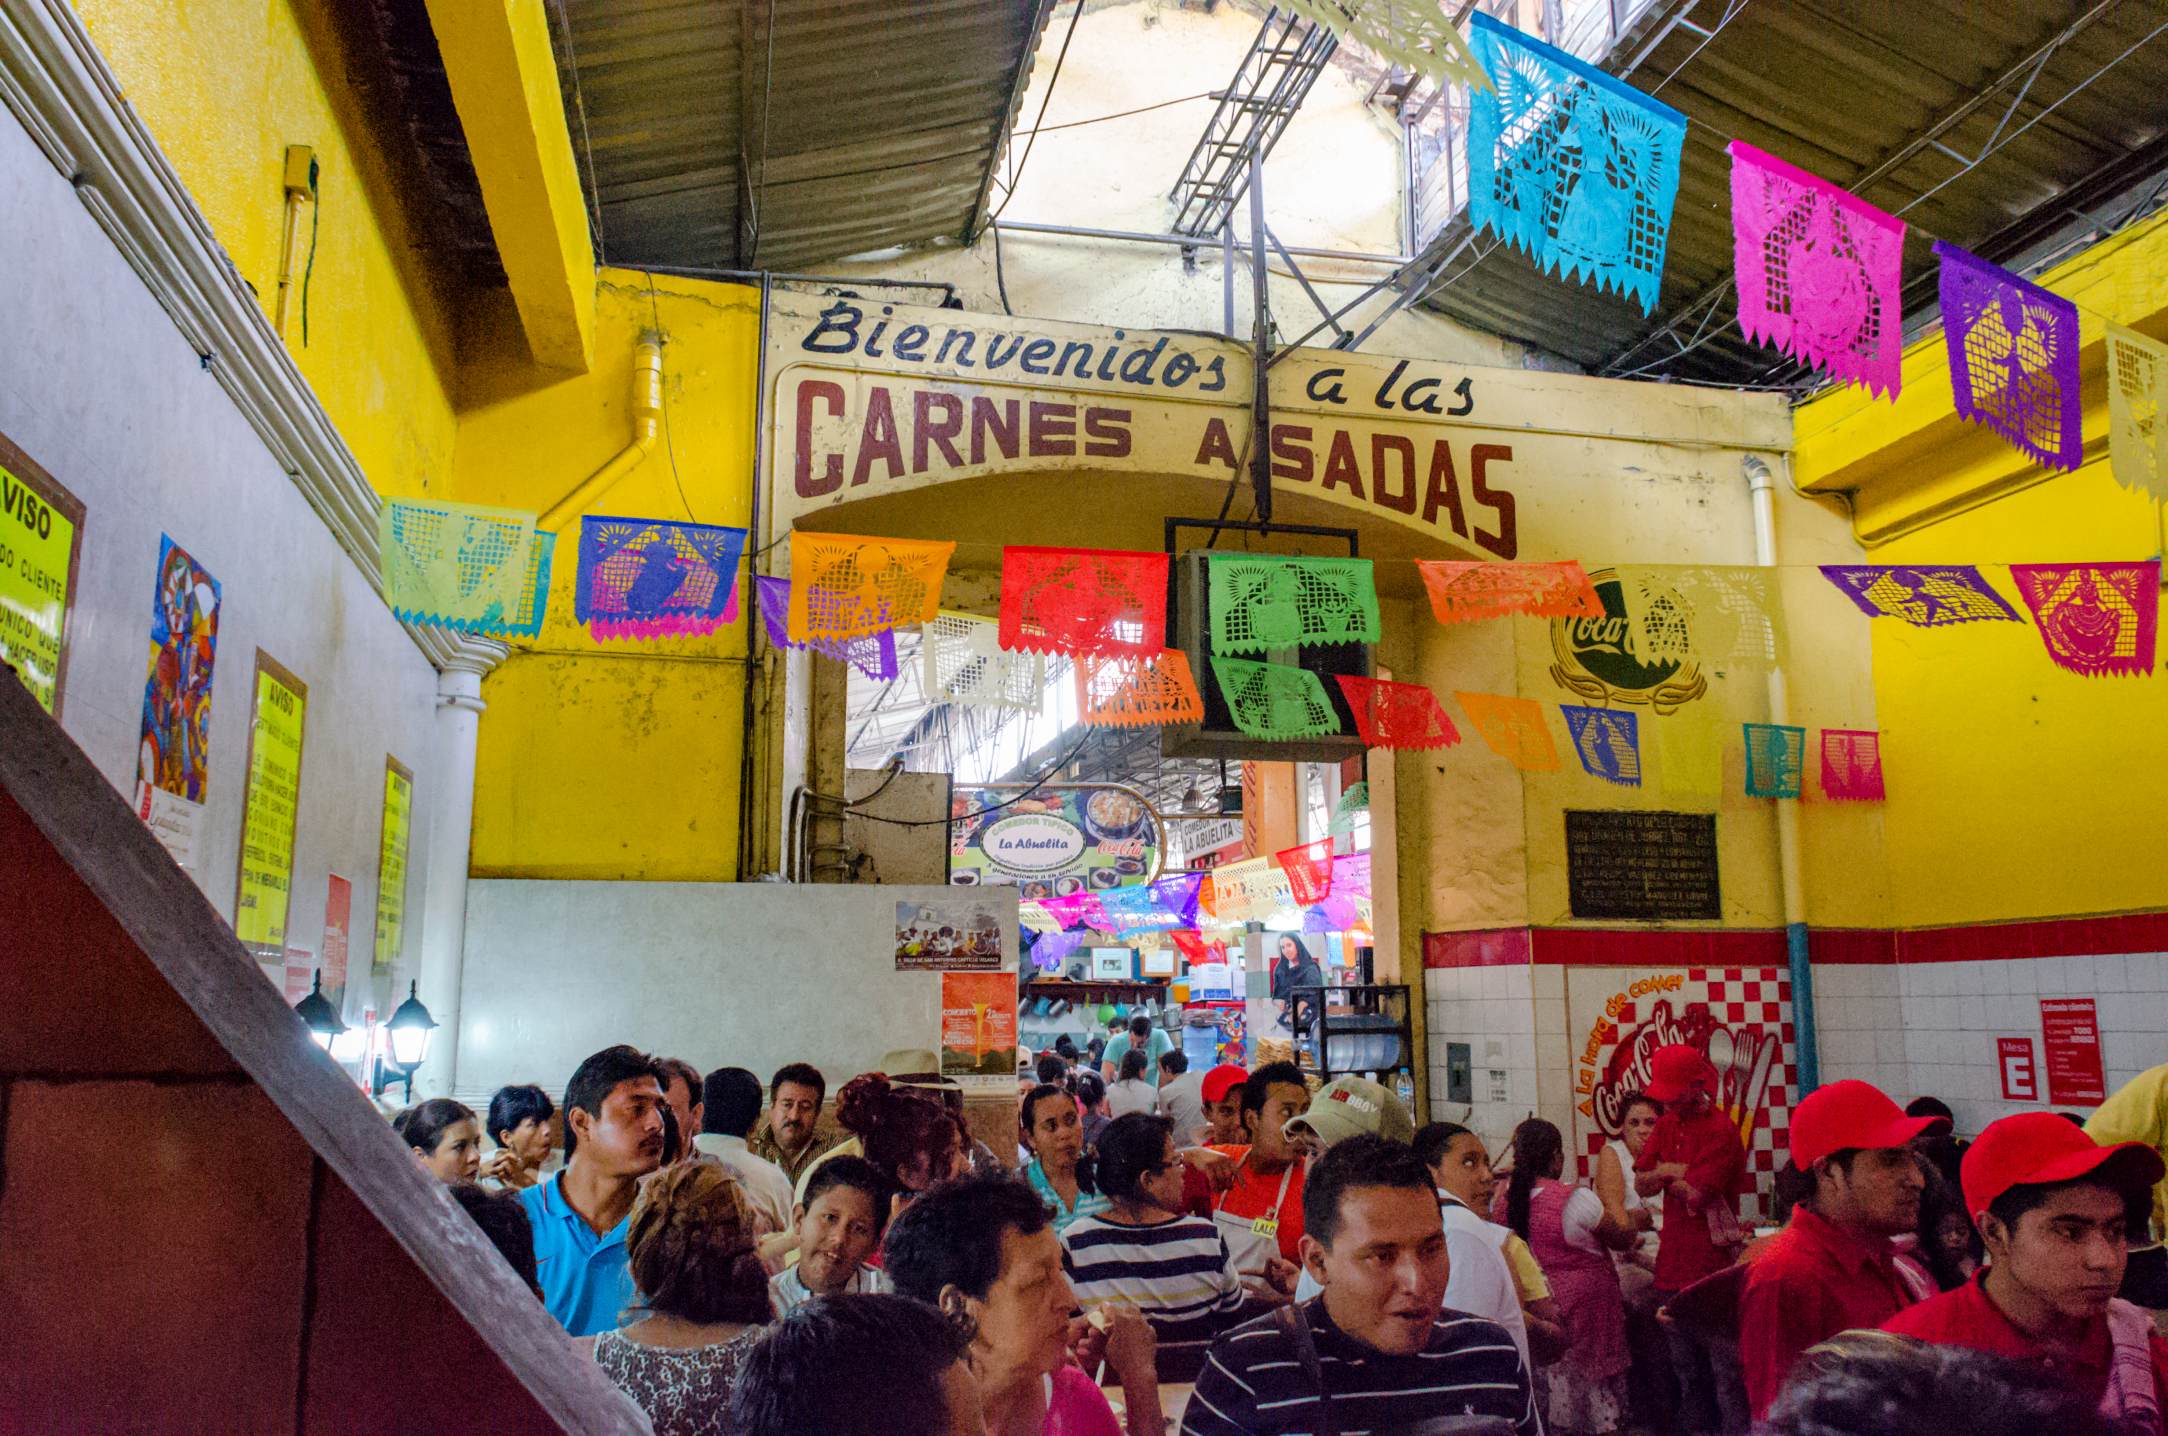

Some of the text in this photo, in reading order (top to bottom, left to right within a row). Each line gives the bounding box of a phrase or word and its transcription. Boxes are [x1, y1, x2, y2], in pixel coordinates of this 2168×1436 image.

[801, 300, 1475, 418] Bienvenidos a las
[796, 379, 1133, 499] CARNES
[0, 476, 51, 541] VISO
[269, 680, 294, 717] AVISO
[999, 838, 1069, 849] La Abuelita
[1184, 821, 1234, 853] LA ABUELITA
[2002, 1042, 2030, 1053] Mesa
[2005, 1056, 2033, 1096] E
